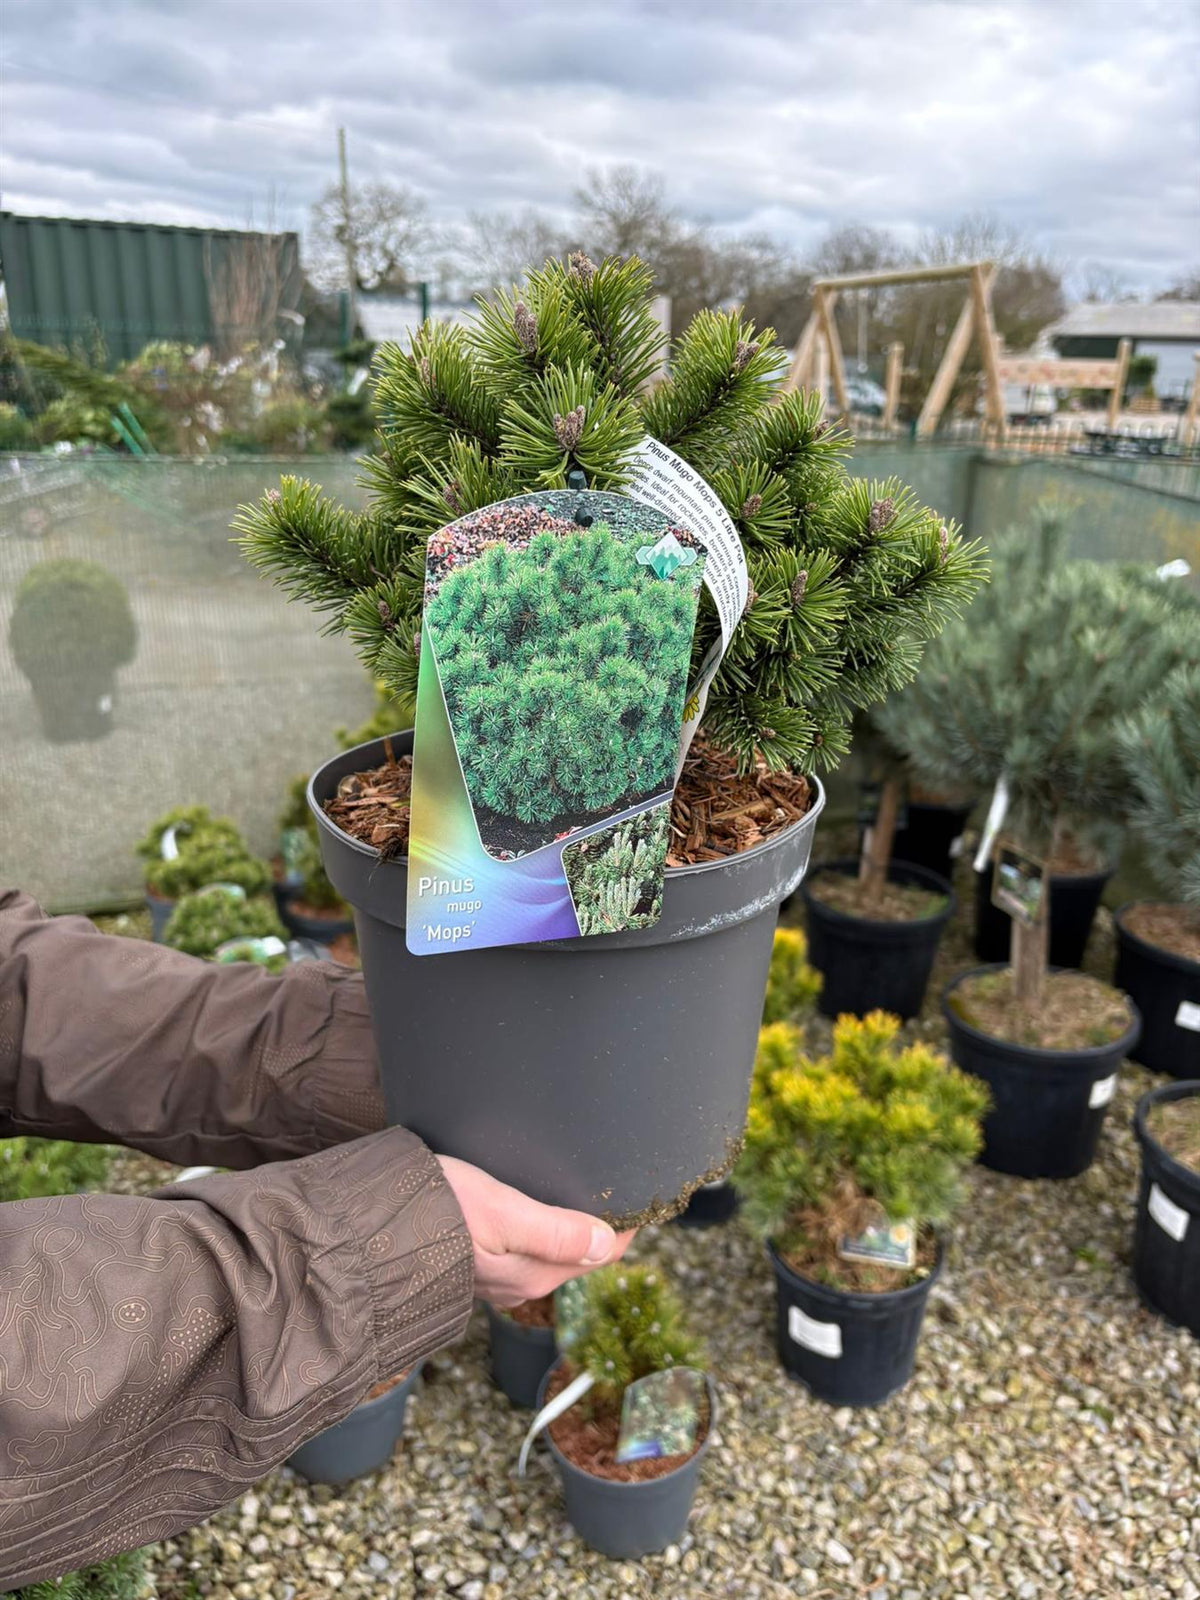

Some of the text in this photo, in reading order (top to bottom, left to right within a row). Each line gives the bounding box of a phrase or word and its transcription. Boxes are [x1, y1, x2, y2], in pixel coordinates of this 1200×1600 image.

[641, 489, 682, 521] well-drained
[645, 441, 743, 565] Pinus Mugo Mops 5 Litre Pot
[650, 480, 670, 497] Ideal
[667, 492, 680, 504] for
[709, 539, 728, 572] borders
[652, 470, 673, 485] dwarf
[671, 483, 703, 514] mountain
[700, 515, 717, 532] pine
[716, 533, 734, 567] forming
[417, 876, 475, 897] Pinus
[447, 899, 482, 914] mugo
